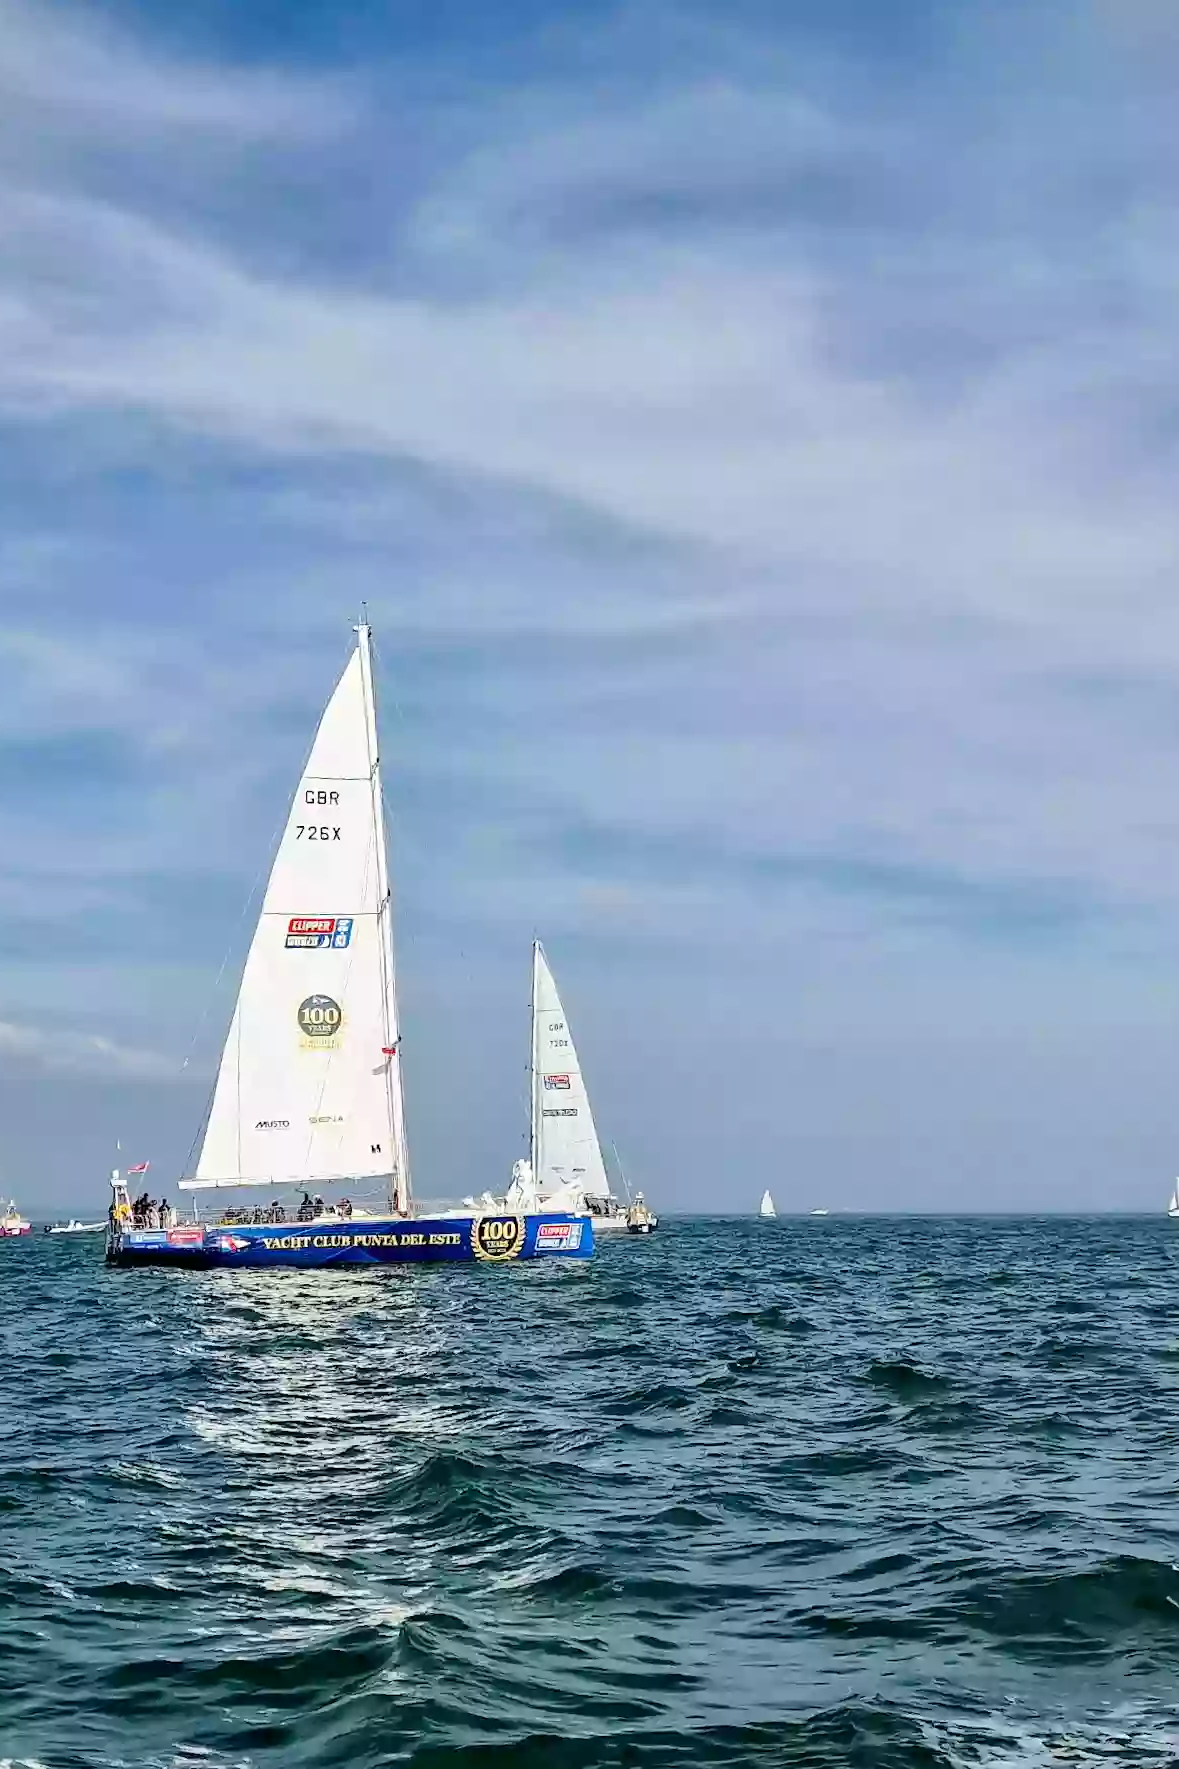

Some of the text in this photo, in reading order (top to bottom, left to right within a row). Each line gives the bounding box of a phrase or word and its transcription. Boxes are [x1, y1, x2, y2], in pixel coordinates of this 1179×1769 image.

[305, 790, 340, 805] GBR
[296, 825, 341, 841] 726X
[291, 920, 332, 932] CLIPPER
[301, 1007, 339, 1025] 100
[255, 1120, 290, 1129] MUSTO
[481, 1220, 517, 1241] 100
[263, 1233, 461, 1249] YACHT CLUB PUNTA DEL ESTE
